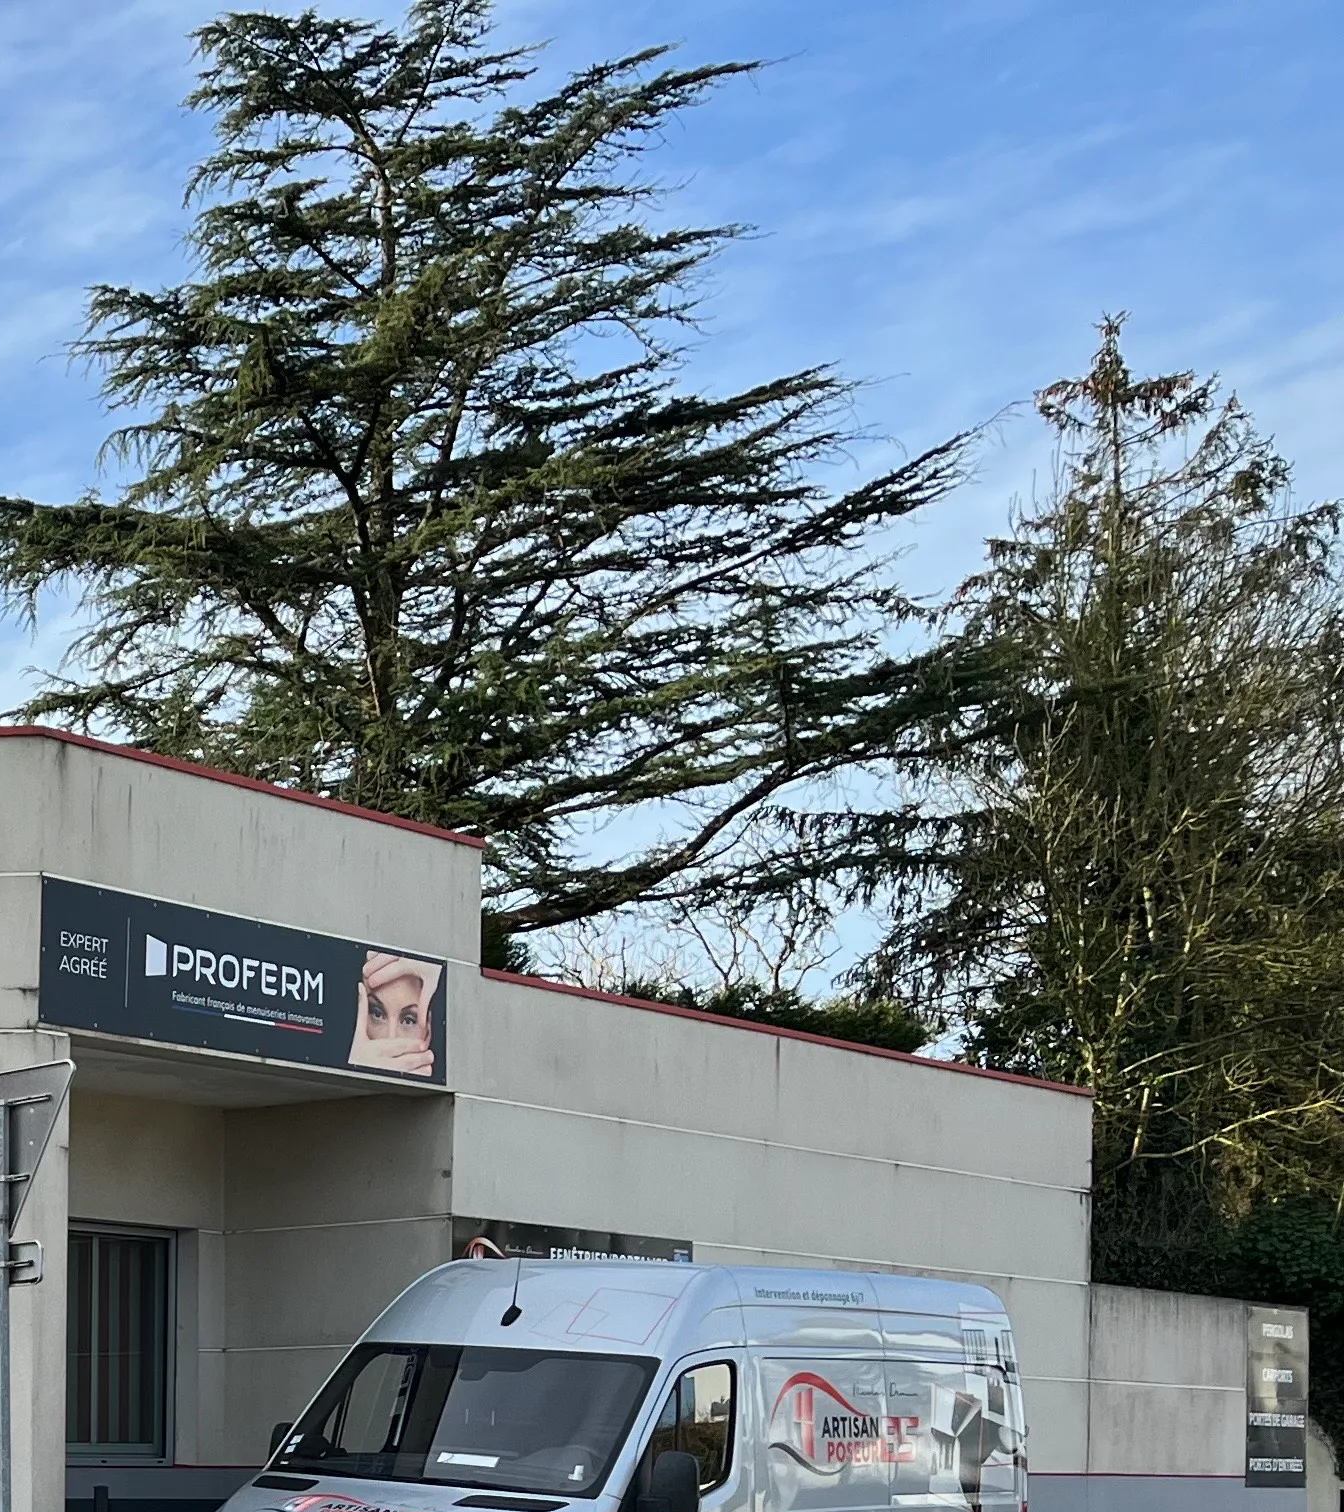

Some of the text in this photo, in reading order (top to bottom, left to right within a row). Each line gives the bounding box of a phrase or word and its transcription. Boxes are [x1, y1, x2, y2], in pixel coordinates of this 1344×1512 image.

[60, 931, 109, 953] EXPERT
[59, 955, 108, 979] AGRÉÉ
[172, 944, 324, 1005] PROFERM
[172, 990, 206, 1007] Fabricant
[207, 996, 235, 1012] français
[236, 1002, 246, 1013] de
[821, 1416, 879, 1438] ARTISAN
[827, 1441, 880, 1463] POSEUR
